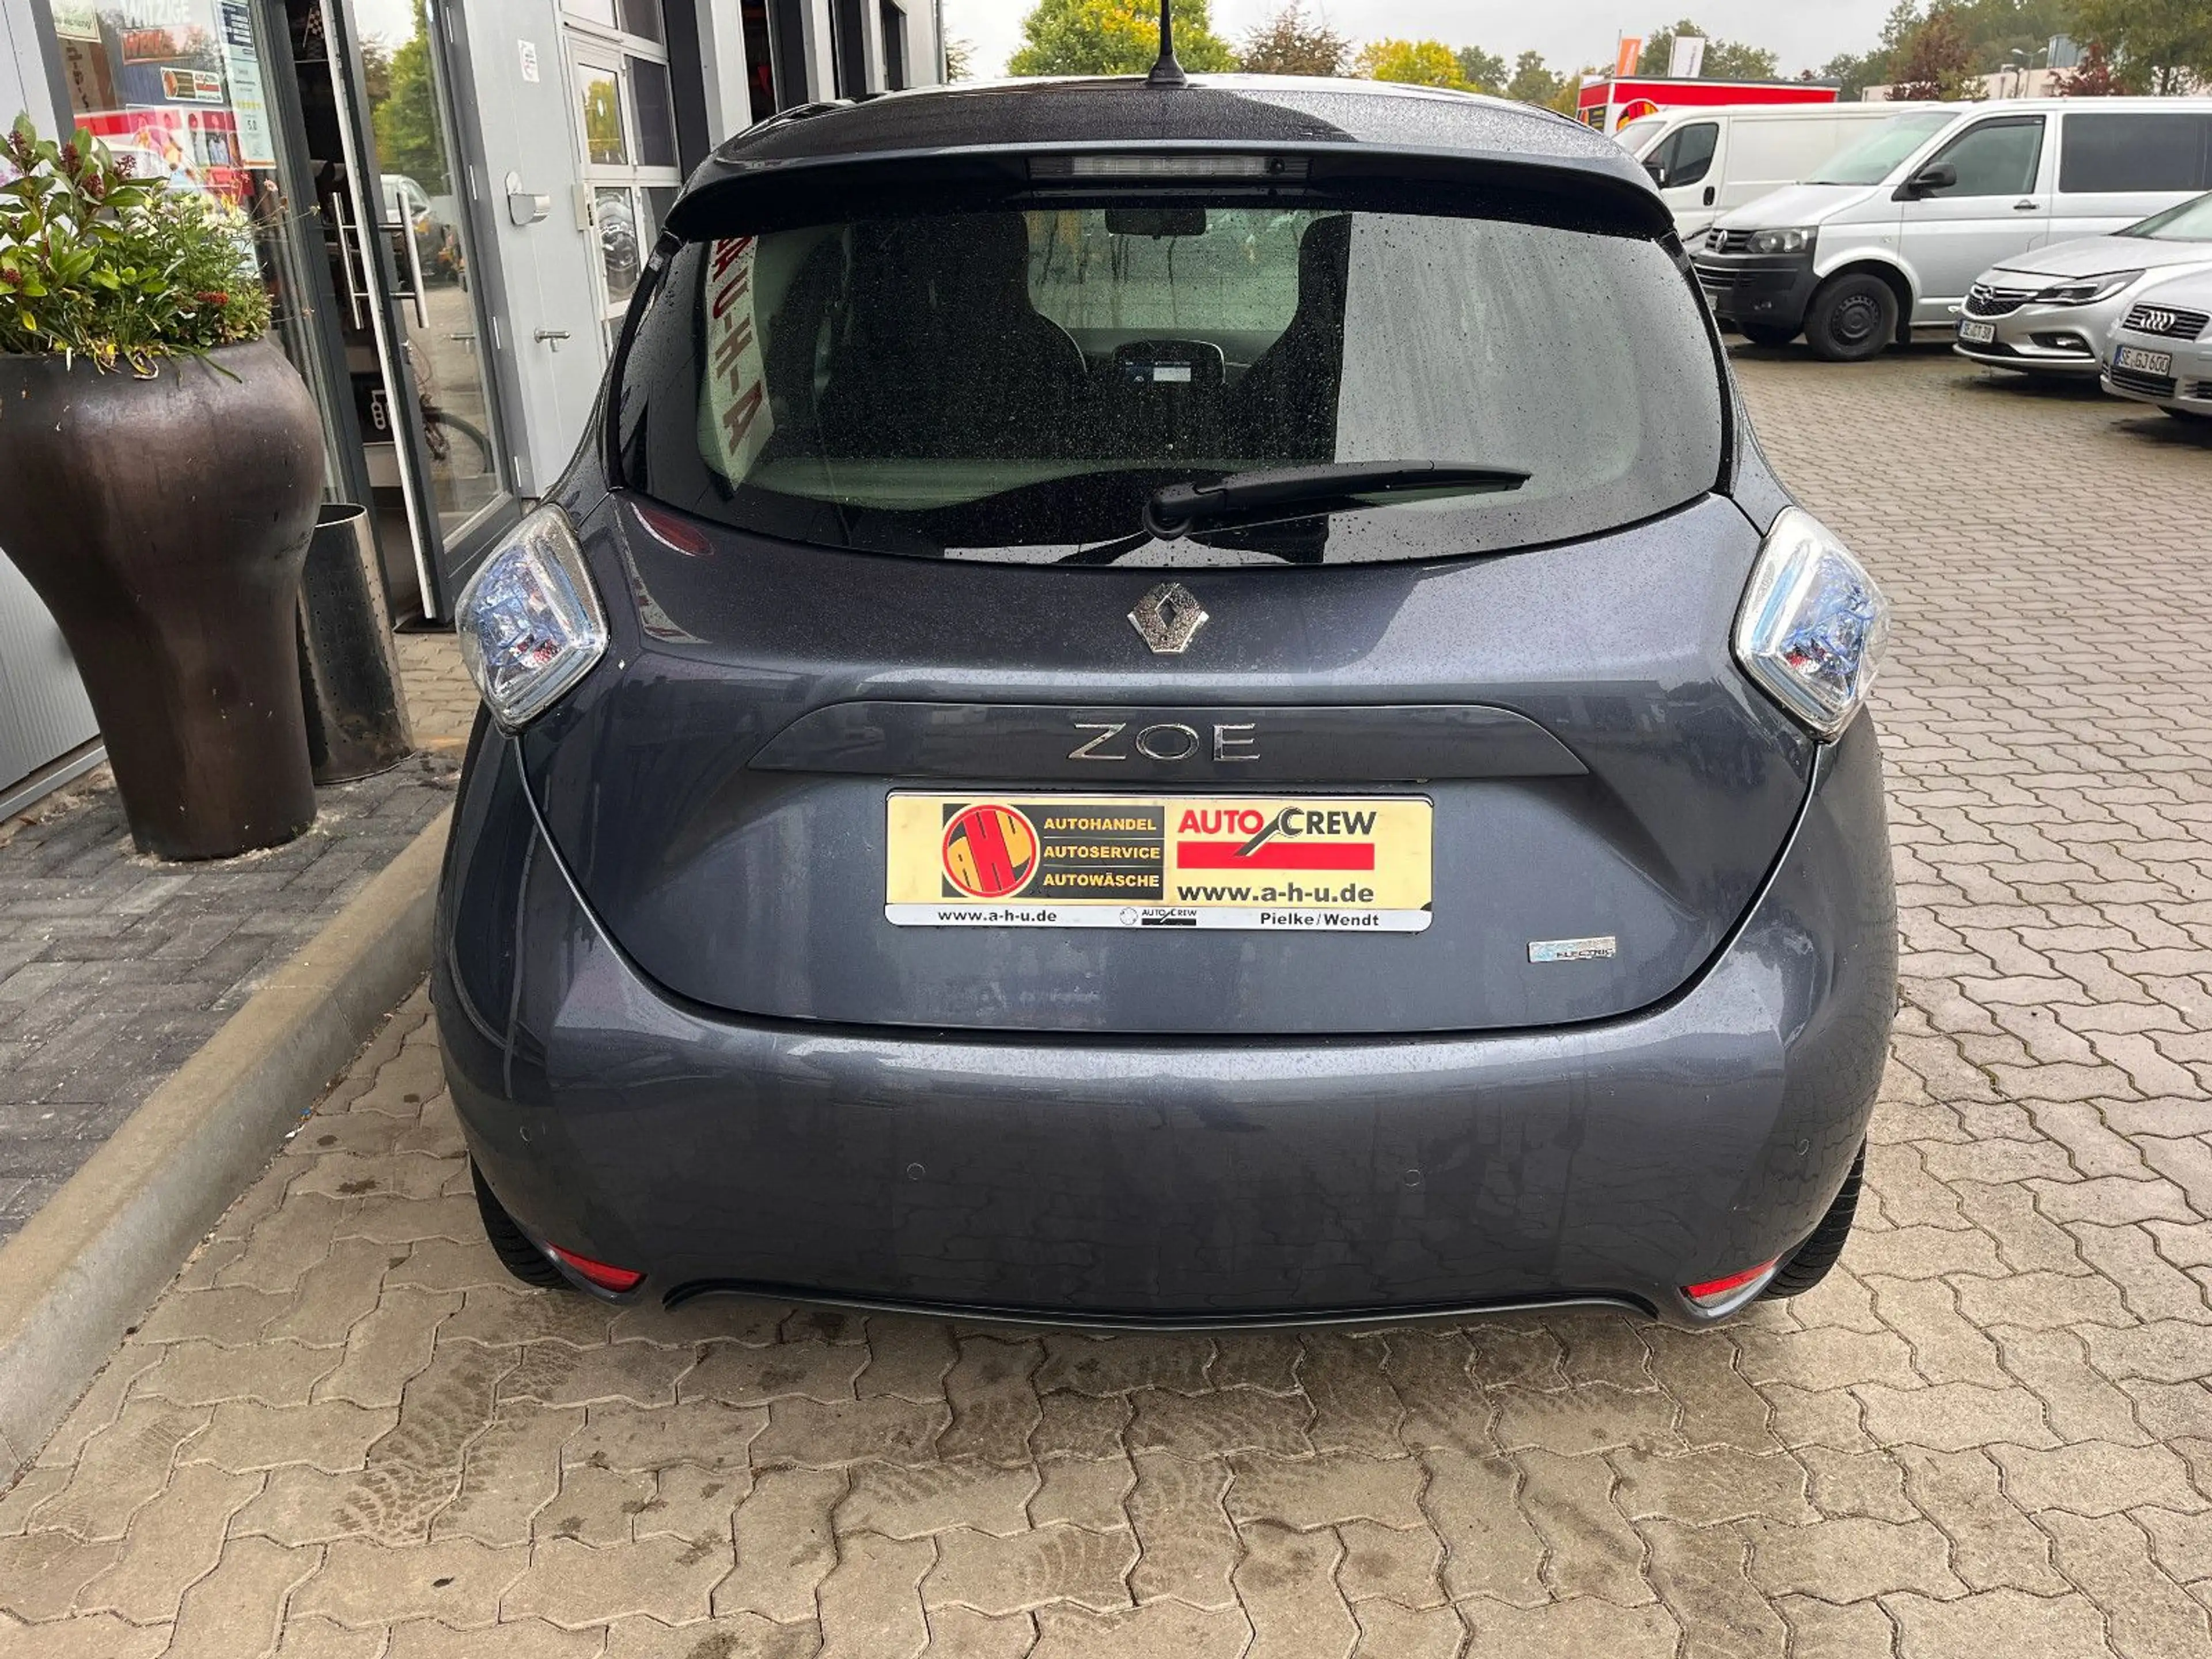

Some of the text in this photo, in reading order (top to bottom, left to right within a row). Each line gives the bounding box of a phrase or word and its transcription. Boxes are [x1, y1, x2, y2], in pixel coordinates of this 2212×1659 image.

[1067, 722, 1260, 762] ZOE
[1044, 817, 1157, 831] AUTOHANDEL
[1178, 806, 1377, 836] AUTO CREW
[1044, 845, 1161, 859] AUTOSERVICE
[1043, 872, 1160, 888] AUTOWÄSCHE
[1177, 882, 1374, 903] www.a-h-u.de
[938, 909, 1058, 923] www.a-h-u.de
[1142, 908, 1198, 916] AUTO CREW
[1260, 912, 1380, 927] Pielke/Wendt
